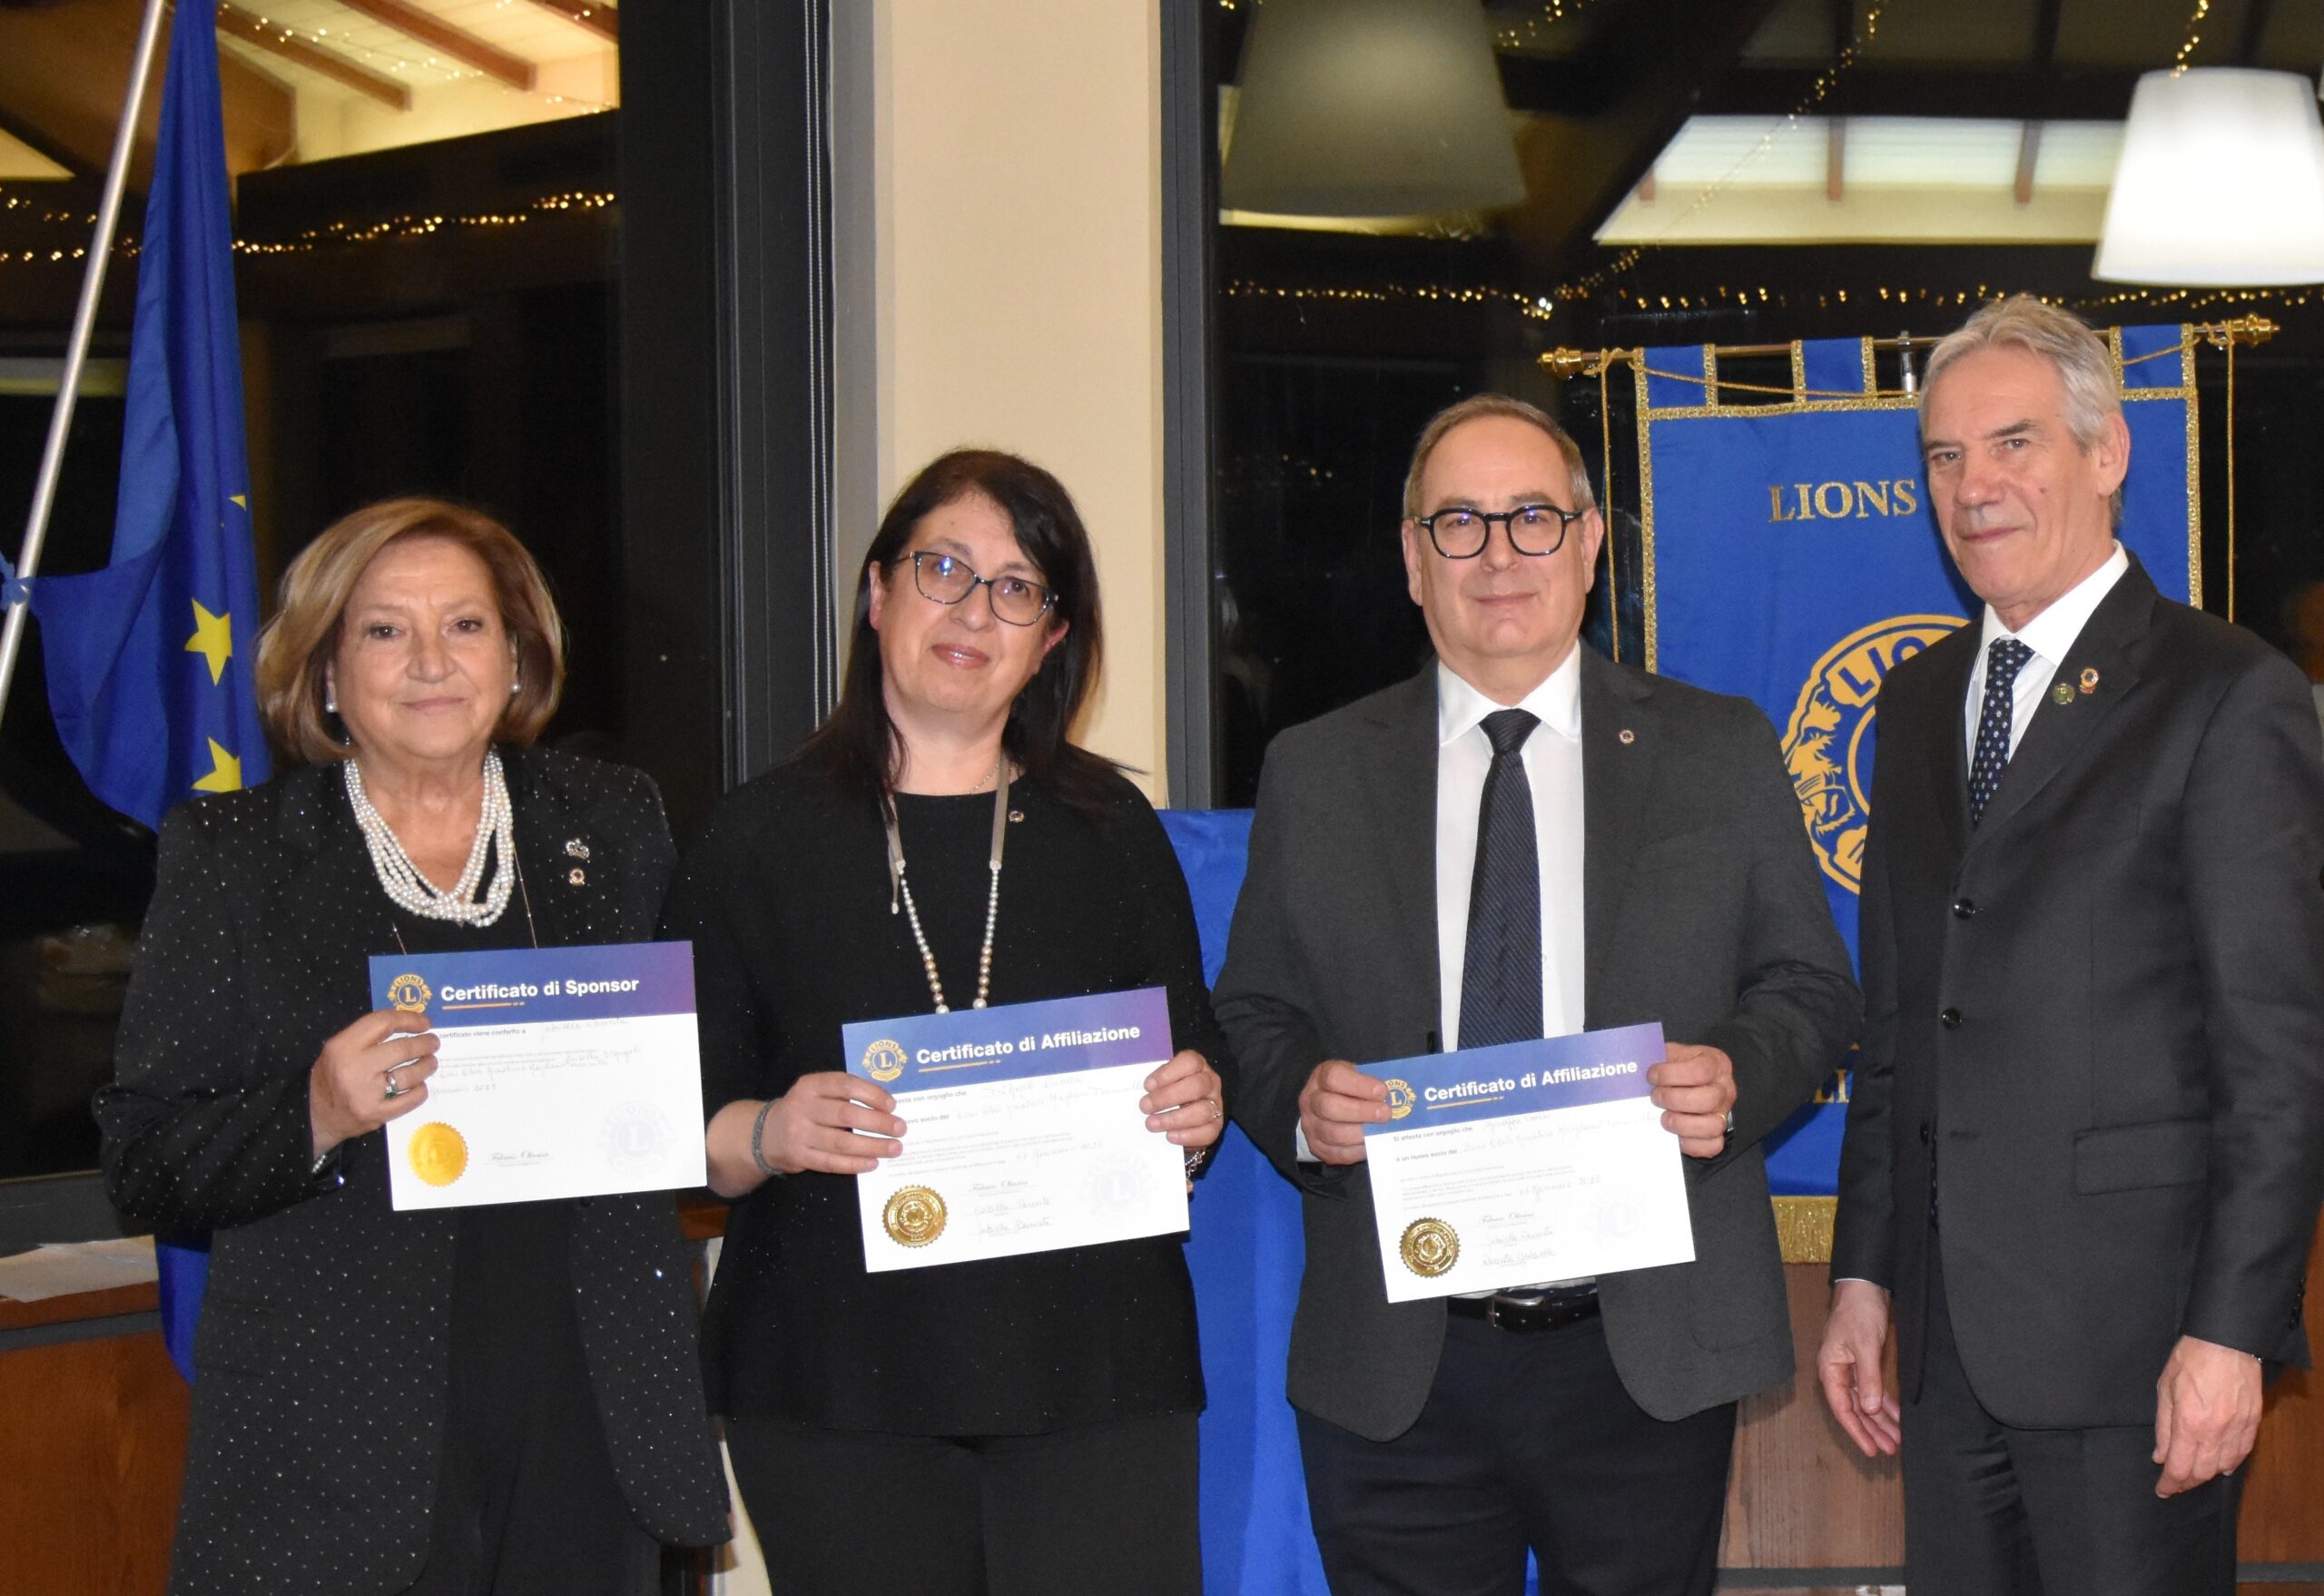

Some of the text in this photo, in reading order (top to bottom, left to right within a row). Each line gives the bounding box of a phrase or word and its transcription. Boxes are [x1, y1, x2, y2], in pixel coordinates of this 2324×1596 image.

[1768, 479, 1917, 523] LIONS
[1837, 636, 1927, 698] LIO
[395, 975, 423, 986] LIONS
[405, 987, 417, 1002] L
[441, 979, 640, 1002] Certificato di Sponsor
[871, 1040, 897, 1051] LIONS
[917, 1025, 1141, 1065] Certificato di Affiliazione
[880, 1052, 892, 1068] L
[1424, 1060, 1638, 1102] Certificato di Affiliazione
[927, 1091, 953, 1101] orgoglio
[1390, 1091, 1402, 1106] L
[1435, 1127, 1461, 1137] orgoglio
[1411, 1152, 1429, 1160] nuovo
